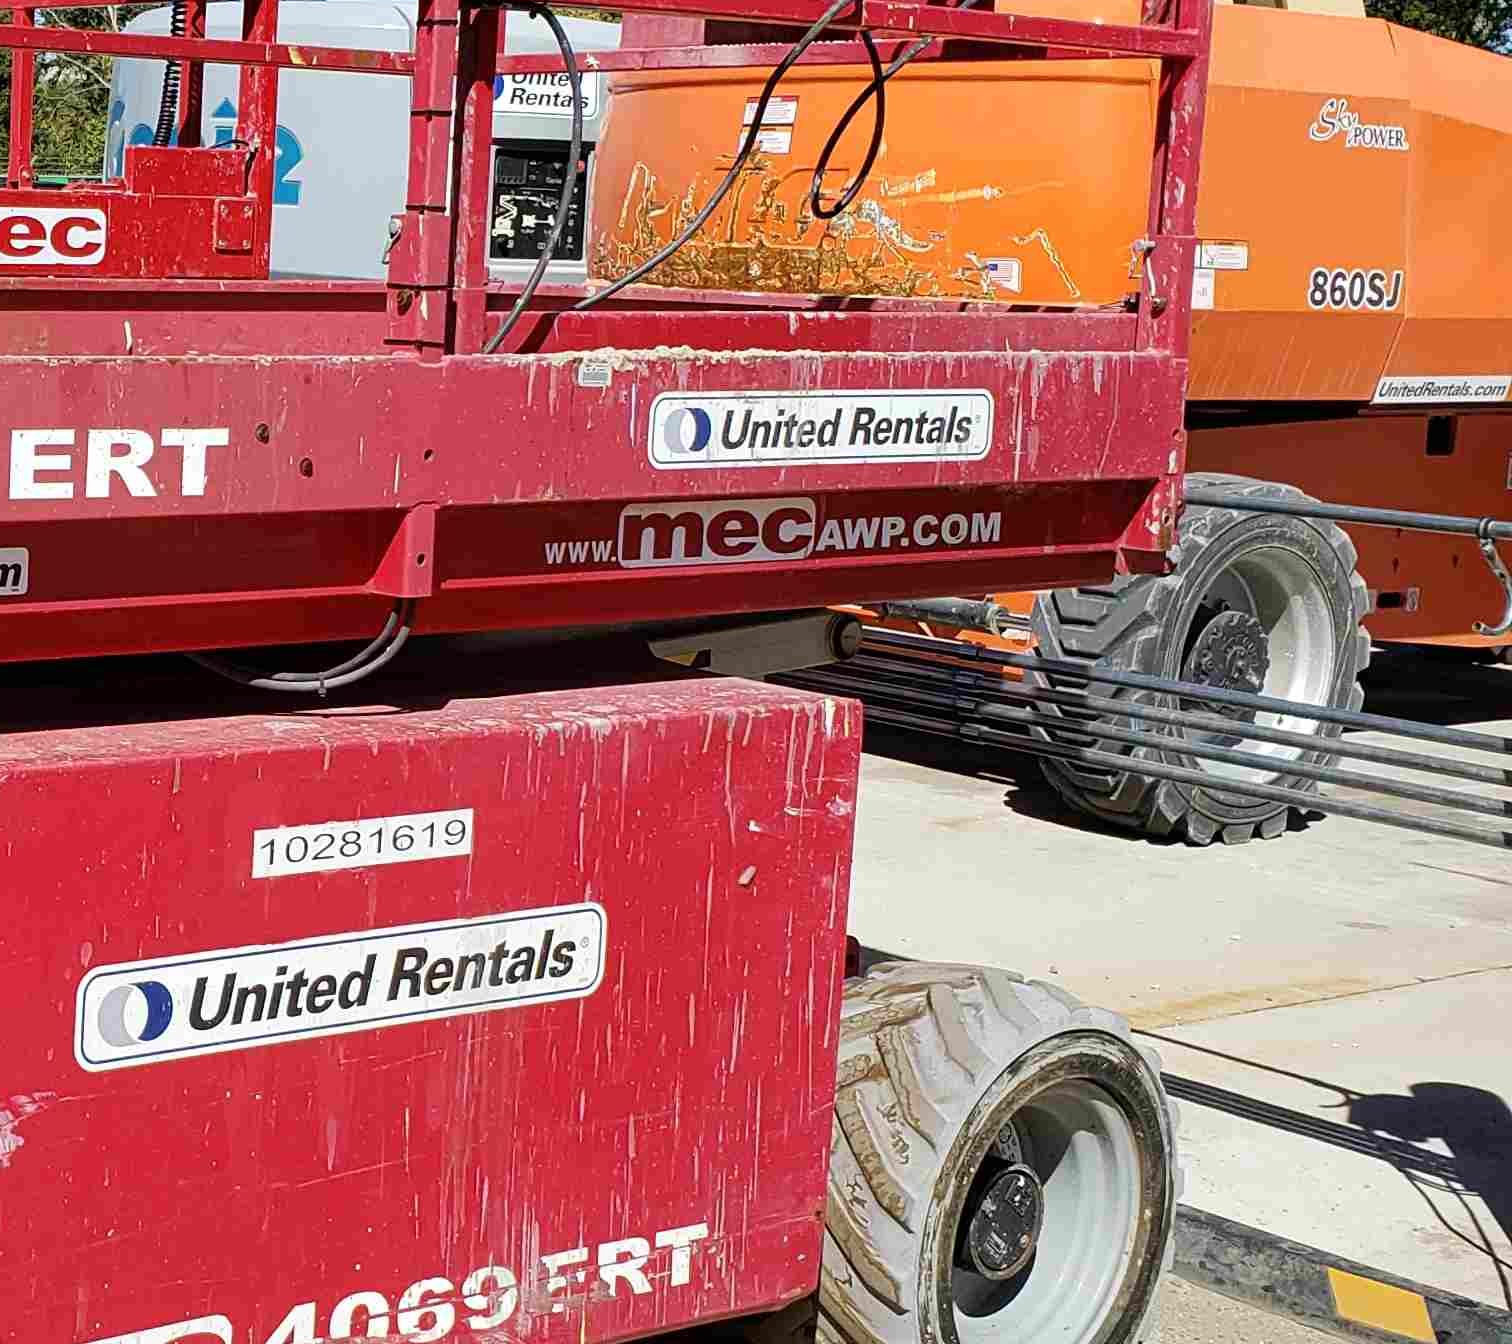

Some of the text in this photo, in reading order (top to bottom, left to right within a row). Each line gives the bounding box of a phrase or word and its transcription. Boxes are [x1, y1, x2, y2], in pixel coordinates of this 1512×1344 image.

[510, 88, 589, 109] Rentas
[511, 72, 583, 87] Unite
[1310, 98, 1405, 147] Sky POWER
[1310, 268, 1403, 308] 860SJ
[1378, 379, 1507, 400] UnitedRentals.com
[721, 405, 973, 451] United Rentals
[9, 428, 229, 500] ERT
[260, 818, 467, 867] 10281619
[188, 930, 576, 1032] United Rentals
[541, 1223, 709, 1314] ERT
